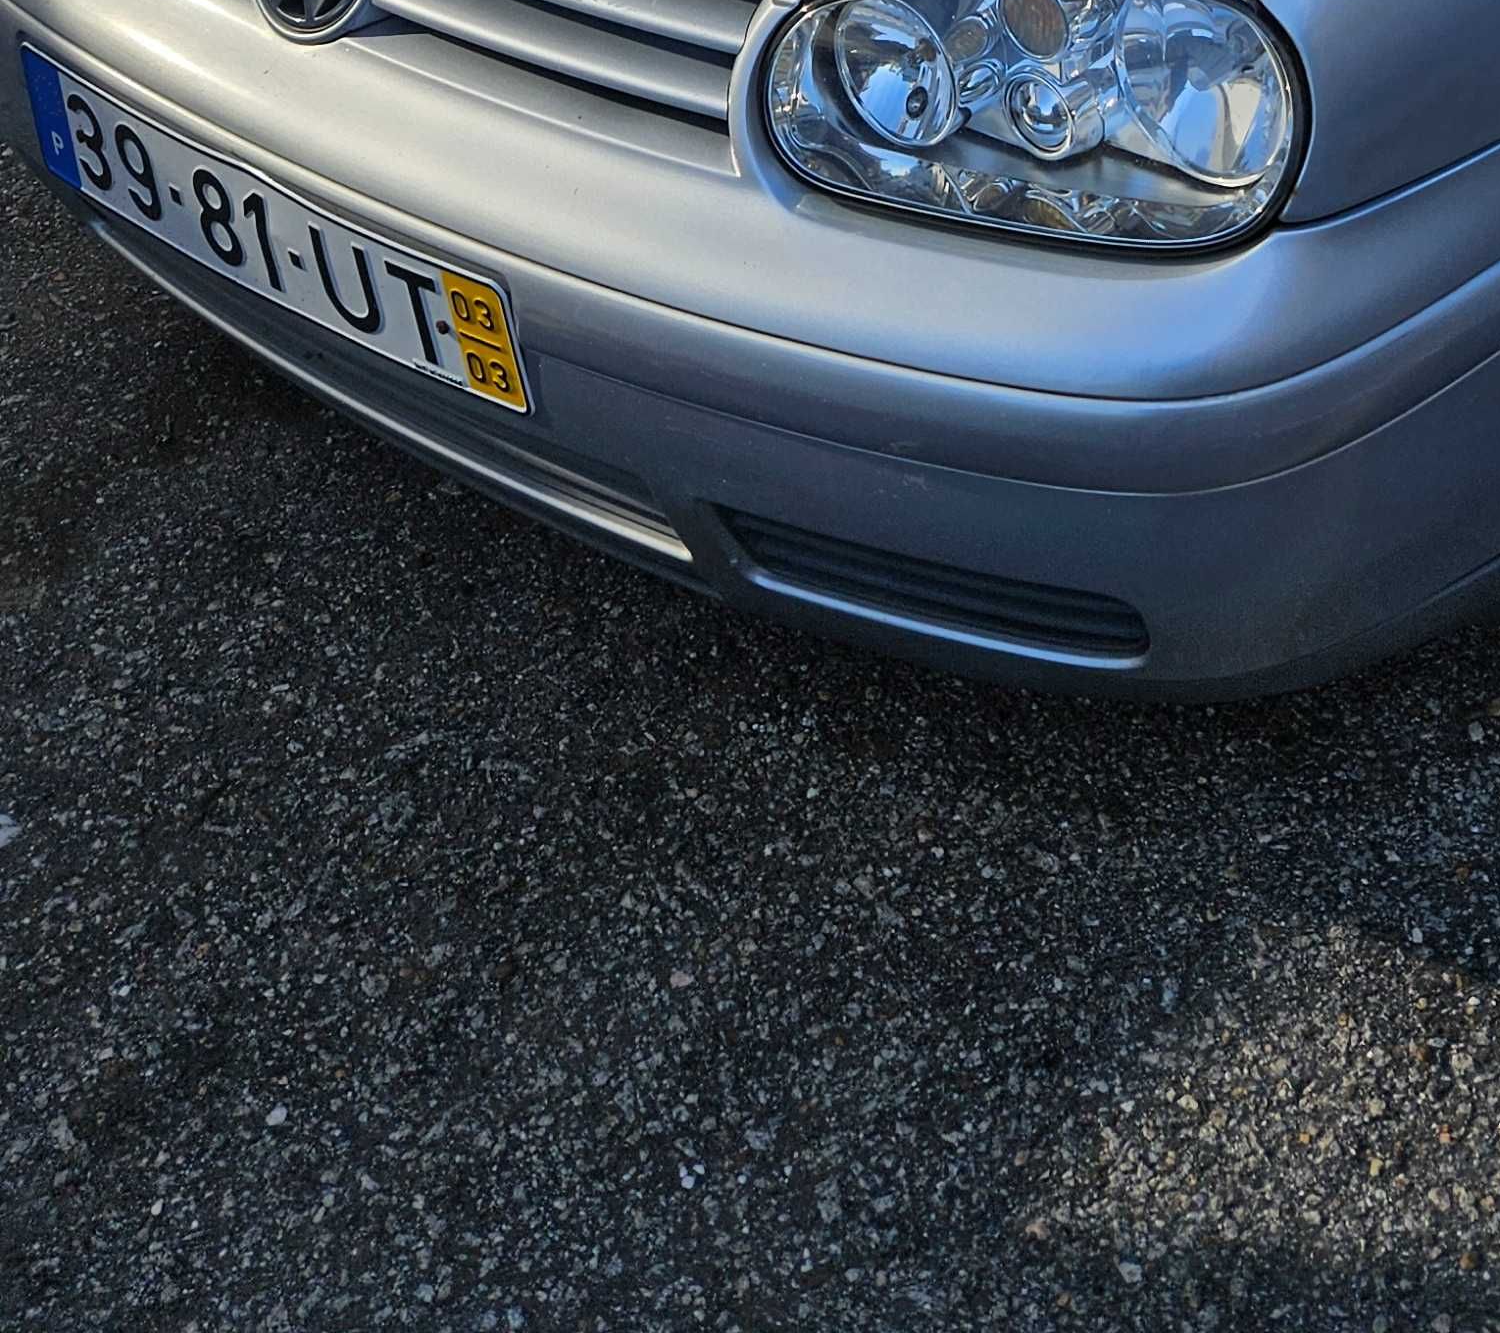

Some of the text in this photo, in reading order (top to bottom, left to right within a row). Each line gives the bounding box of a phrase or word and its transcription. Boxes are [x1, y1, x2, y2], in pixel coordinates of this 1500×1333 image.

[50, 130, 65, 156] P
[450, 289, 495, 331] 03
[465, 351, 511, 393] 03
